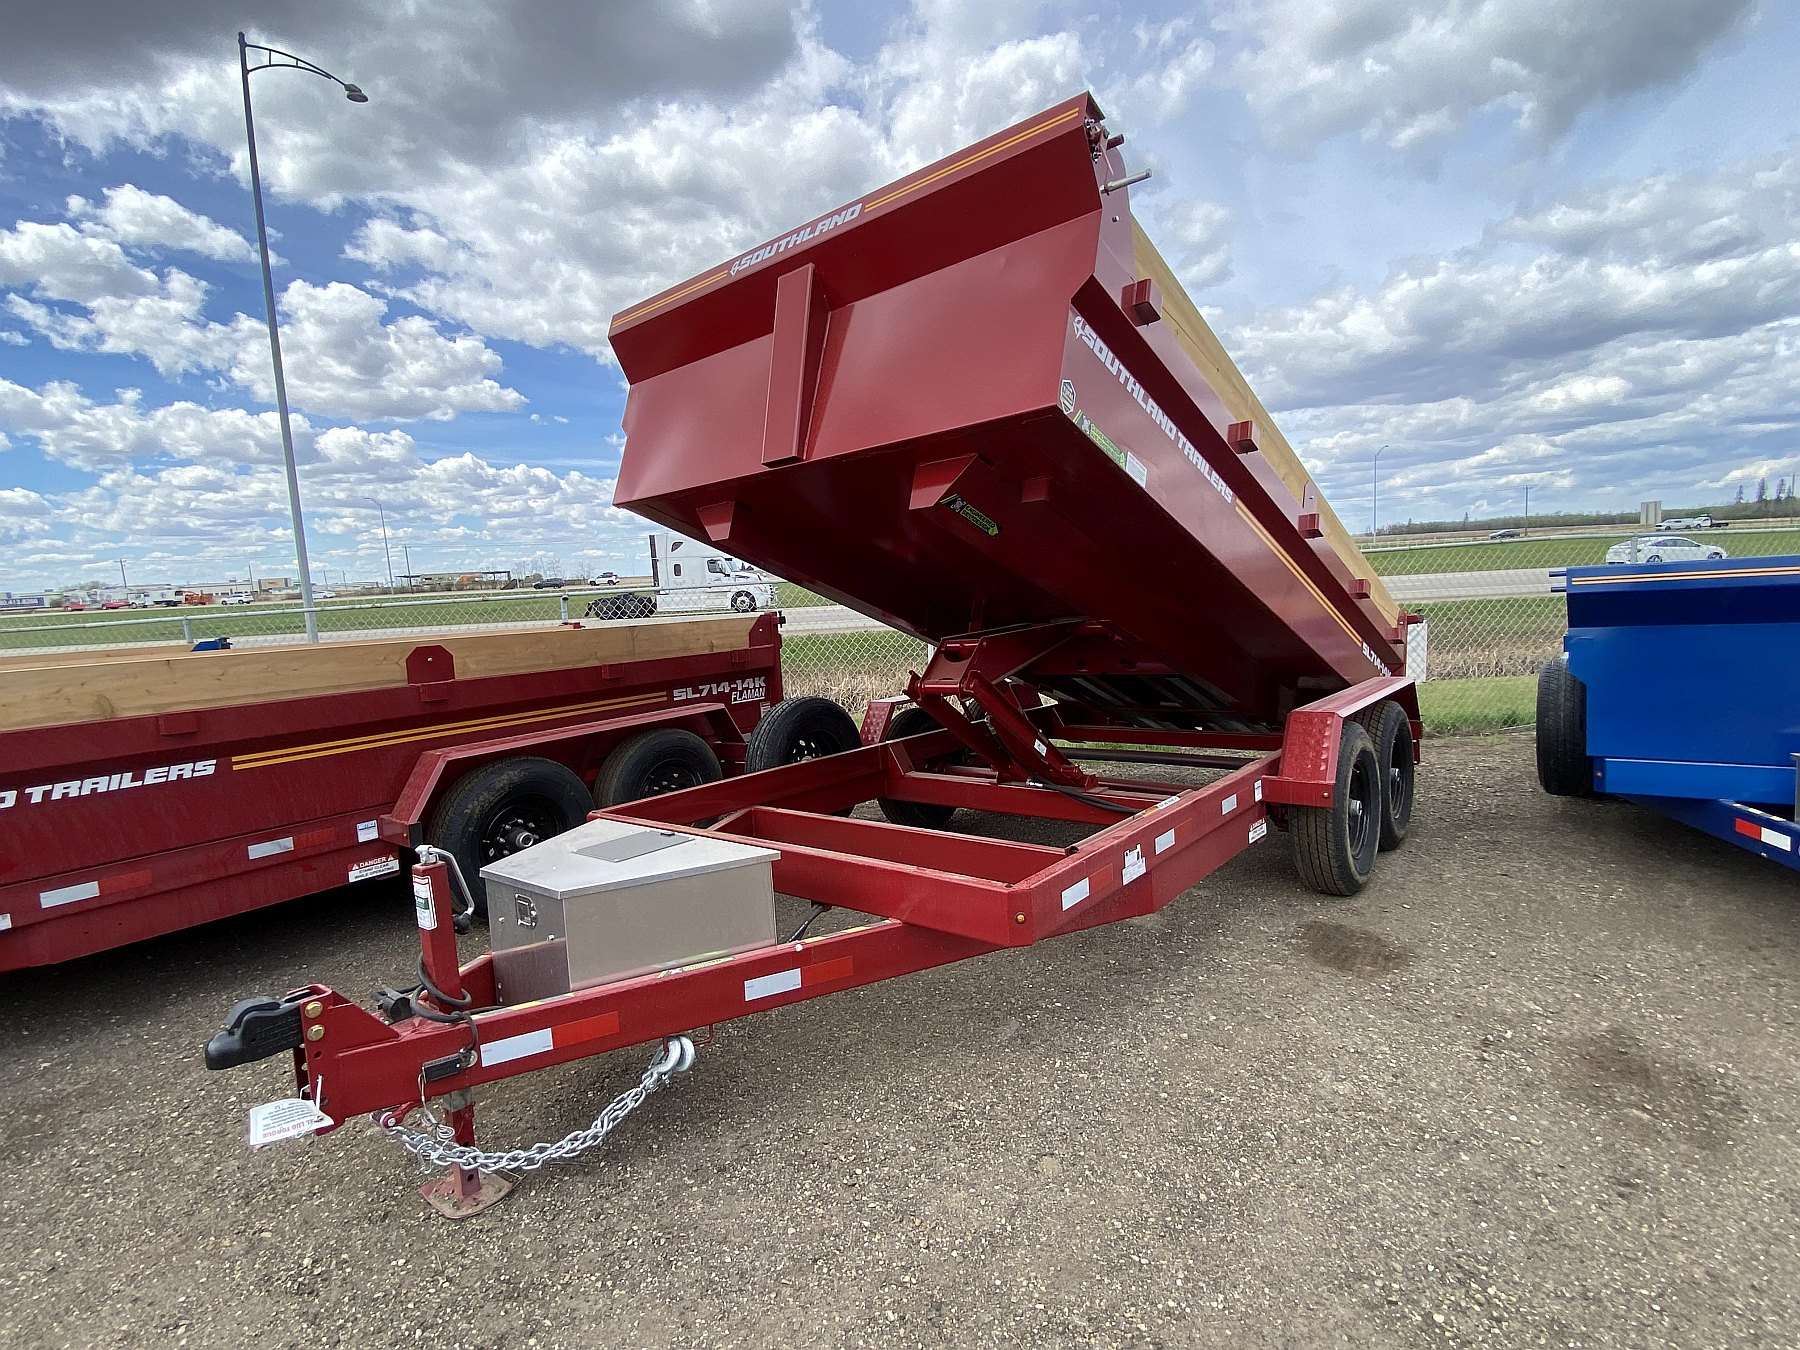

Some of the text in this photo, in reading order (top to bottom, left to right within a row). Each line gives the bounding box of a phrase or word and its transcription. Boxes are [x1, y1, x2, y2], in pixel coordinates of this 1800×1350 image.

[738, 203, 862, 271] SOUTHLAND
[1082, 323, 1178, 440] SOUTHLAND
[1176, 431, 1233, 504] TRAILERS
[673, 677, 766, 701] SL714-14K
[731, 687, 765, 703] FLAMAN
[25, 759, 217, 804] TRAILERS
[360, 856, 387, 868] DANGER
